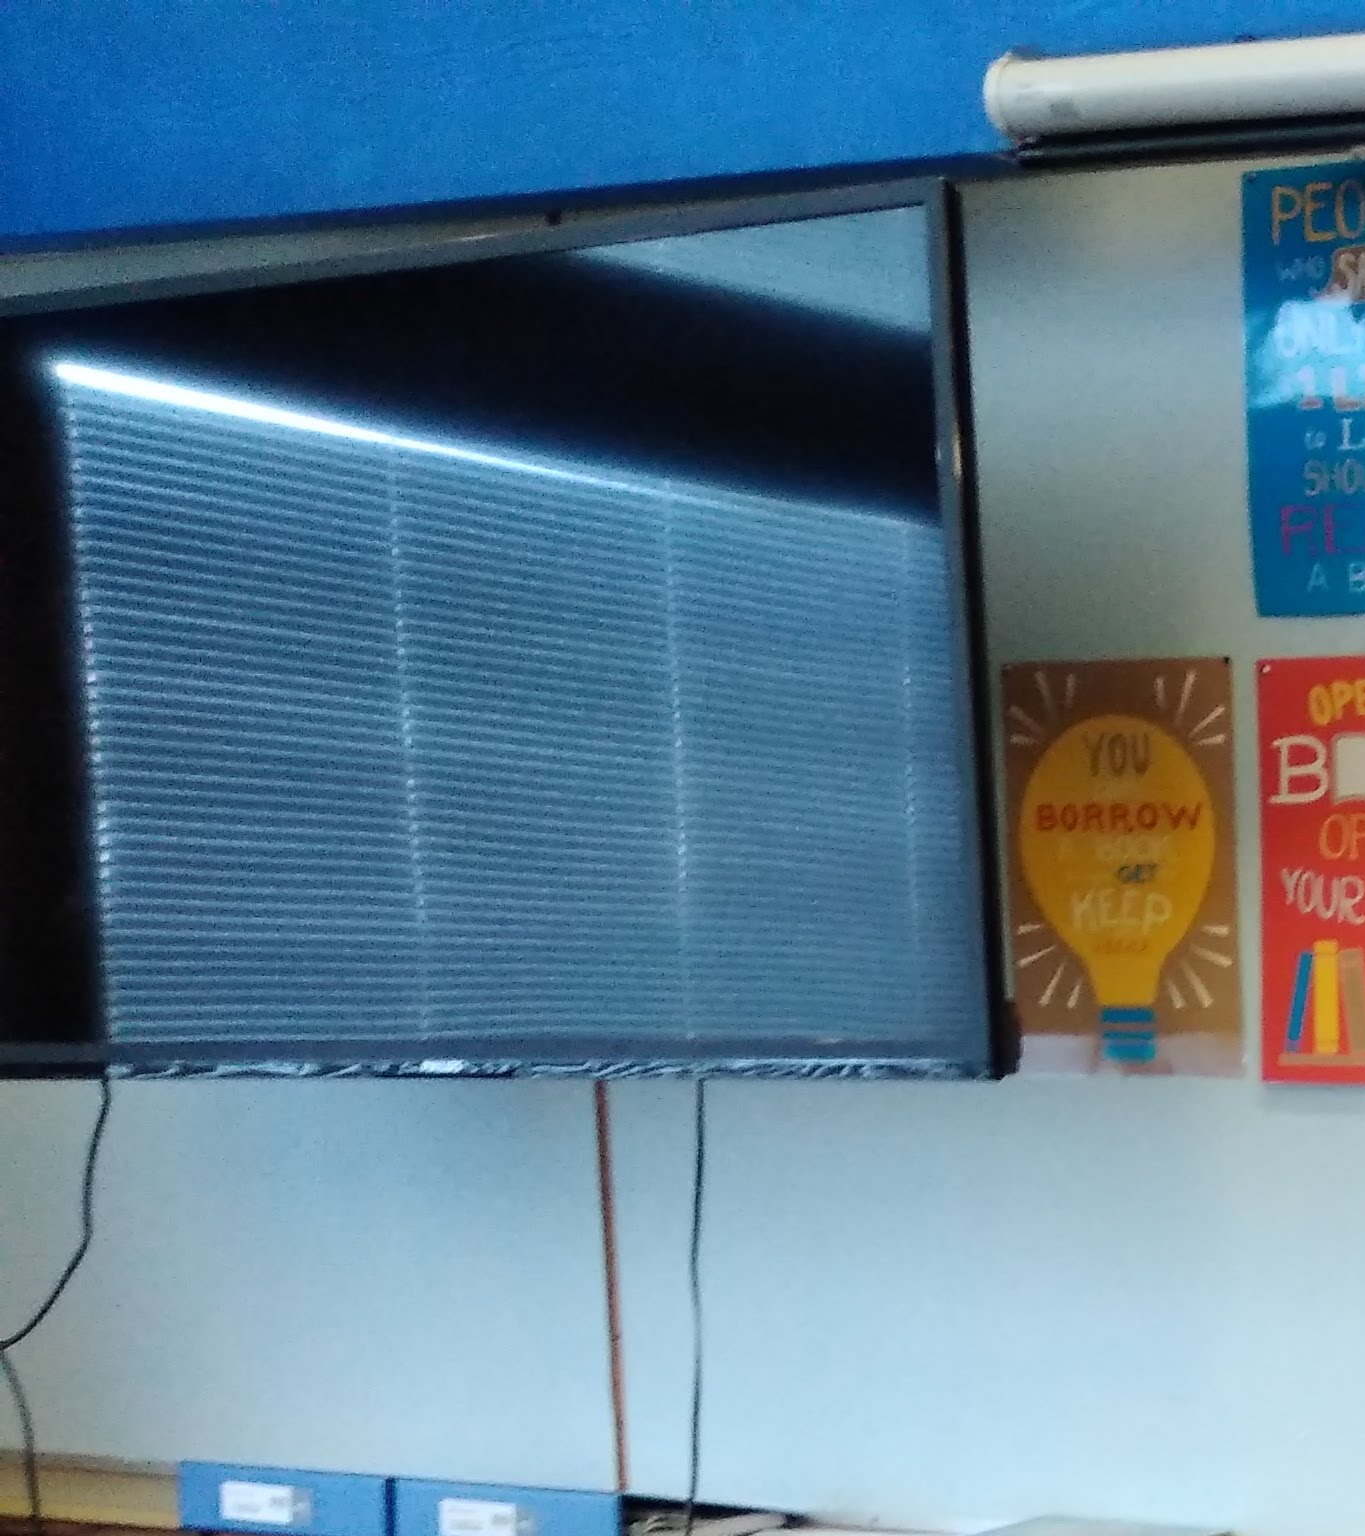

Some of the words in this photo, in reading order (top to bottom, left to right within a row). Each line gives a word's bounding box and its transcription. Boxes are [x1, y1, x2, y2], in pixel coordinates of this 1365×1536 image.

[1082, 732, 1153, 778] YOU
[1035, 802, 1202, 832] BORROW
[1070, 889, 1174, 935] KEEP
